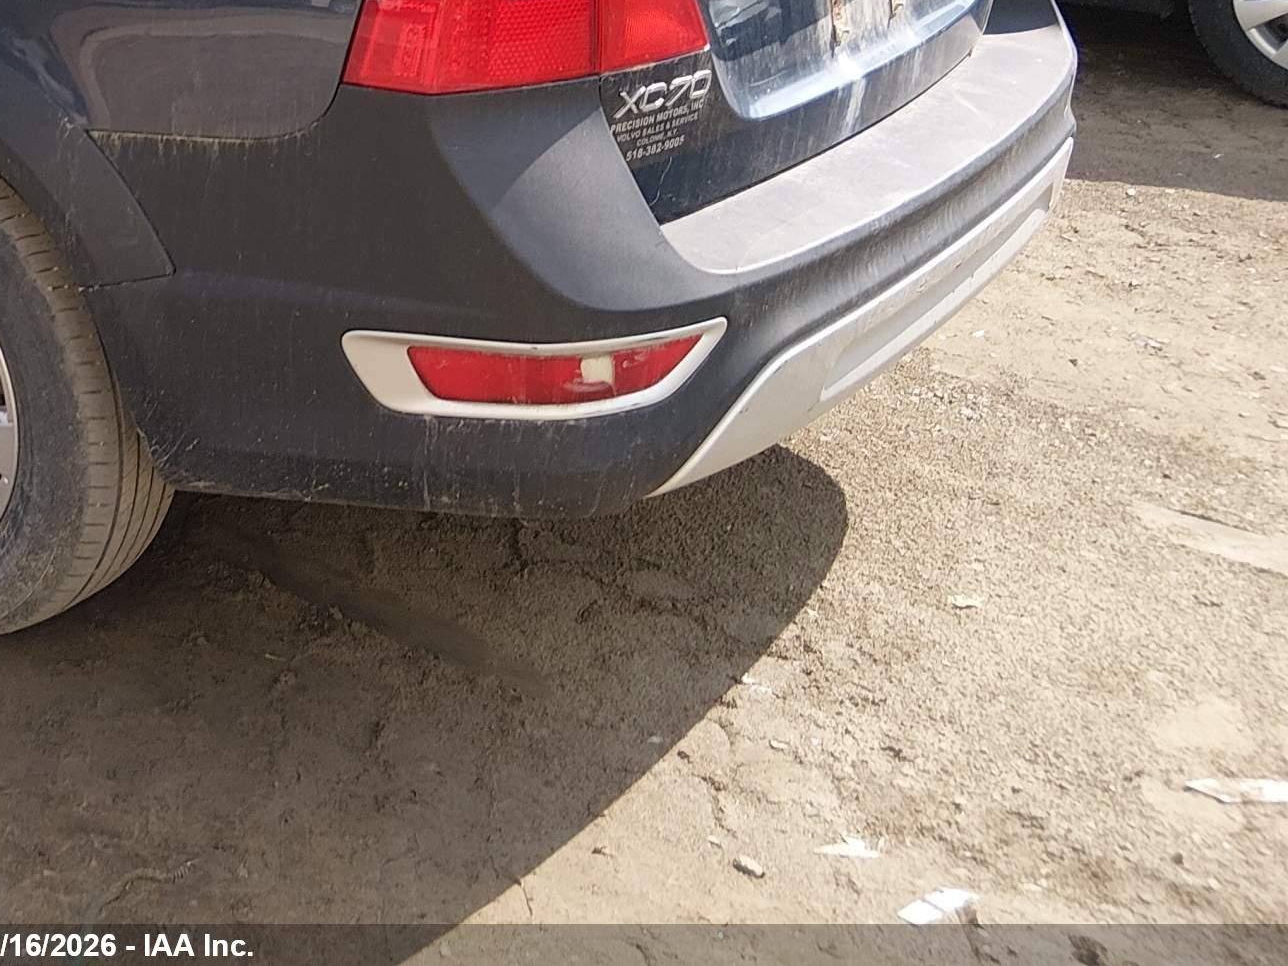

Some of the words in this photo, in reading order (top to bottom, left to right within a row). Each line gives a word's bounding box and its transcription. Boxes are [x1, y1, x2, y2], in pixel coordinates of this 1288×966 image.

[613, 69, 712, 119] XC70
[611, 114, 655, 134] PRECISION
[617, 129, 641, 142] VOLVO
